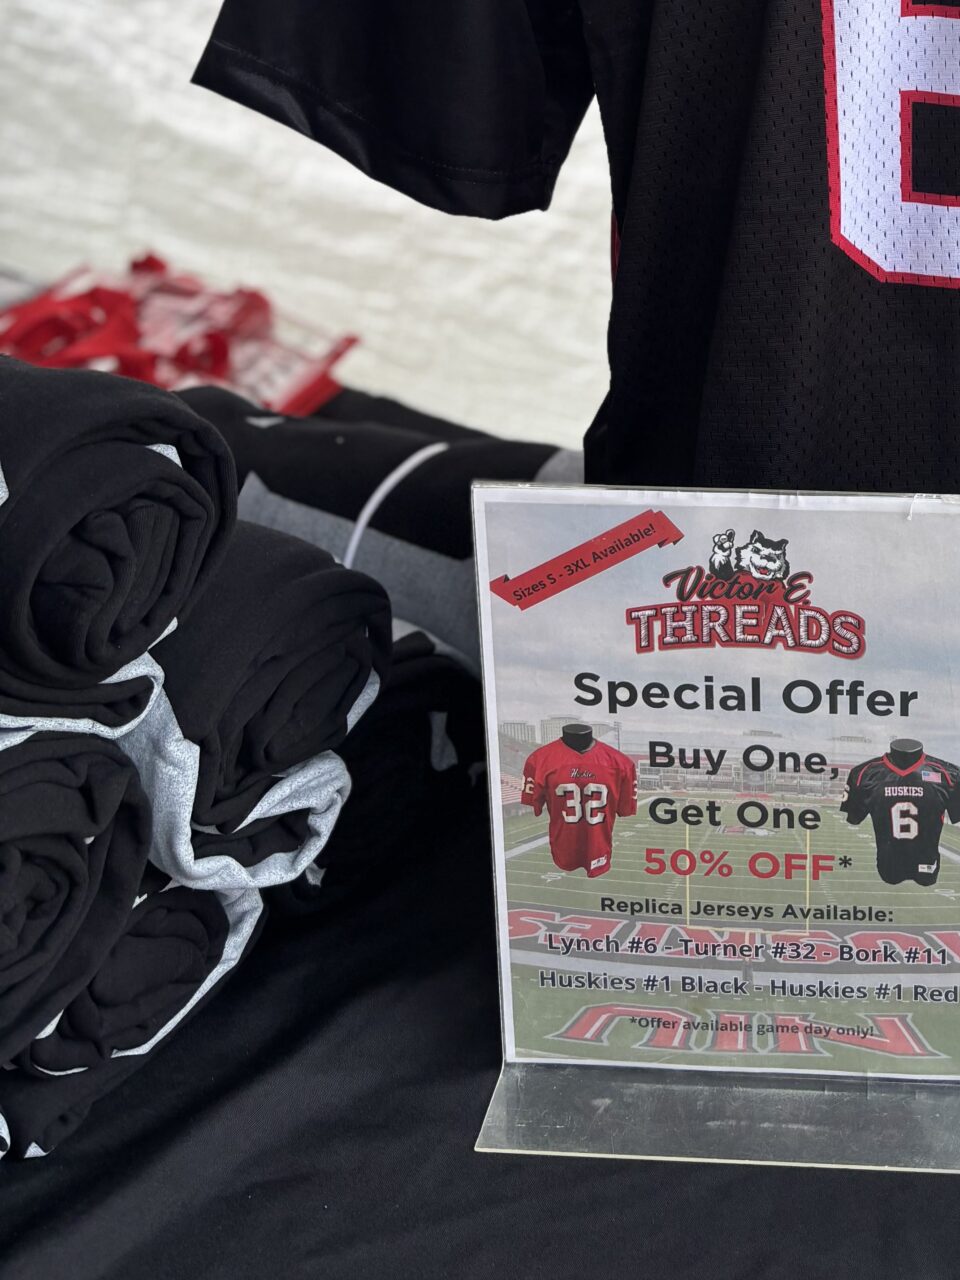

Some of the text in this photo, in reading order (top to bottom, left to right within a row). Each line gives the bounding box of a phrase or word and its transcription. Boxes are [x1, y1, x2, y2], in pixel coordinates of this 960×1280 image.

[513, 578, 547, 602] Sizes
[549, 573, 557, 586] S
[564, 557, 591, 578] 3XL
[592, 523, 657, 563] Available!
[663, 566, 778, 602] Victor
[629, 603, 863, 655] THREADS
[574, 672, 919, 717] Special Offer
[649, 741, 839, 780] Buy One,
[555, 782, 609, 825] 32
[884, 786, 924, 798] HUSKIES
[649, 798, 821, 830] Get One
[890, 801, 920, 840] 6
[644, 848, 733, 878] 50%
[601, 897, 894, 922] Replica Jerseys Available:
[547, 933, 620, 955] Lynch
[627, 937, 658, 954] #6
[678, 938, 764, 958] Turner
[771, 942, 817, 960] #32
[839, 944, 898, 963] Bork
[904, 948, 948, 965] #11
[539, 970, 636, 991] Huskies
[643, 975, 671, 992] #1
[681, 975, 749, 995] Black
[770, 979, 868, 999] Huskies
[875, 983, 903, 1000] #1
[912, 984, 959, 1003] Red
[683, 1019, 752, 1032] available
[756, 1023, 799, 1035] game
[804, 1022, 831, 1037] day
[836, 1025, 874, 1039] only!
